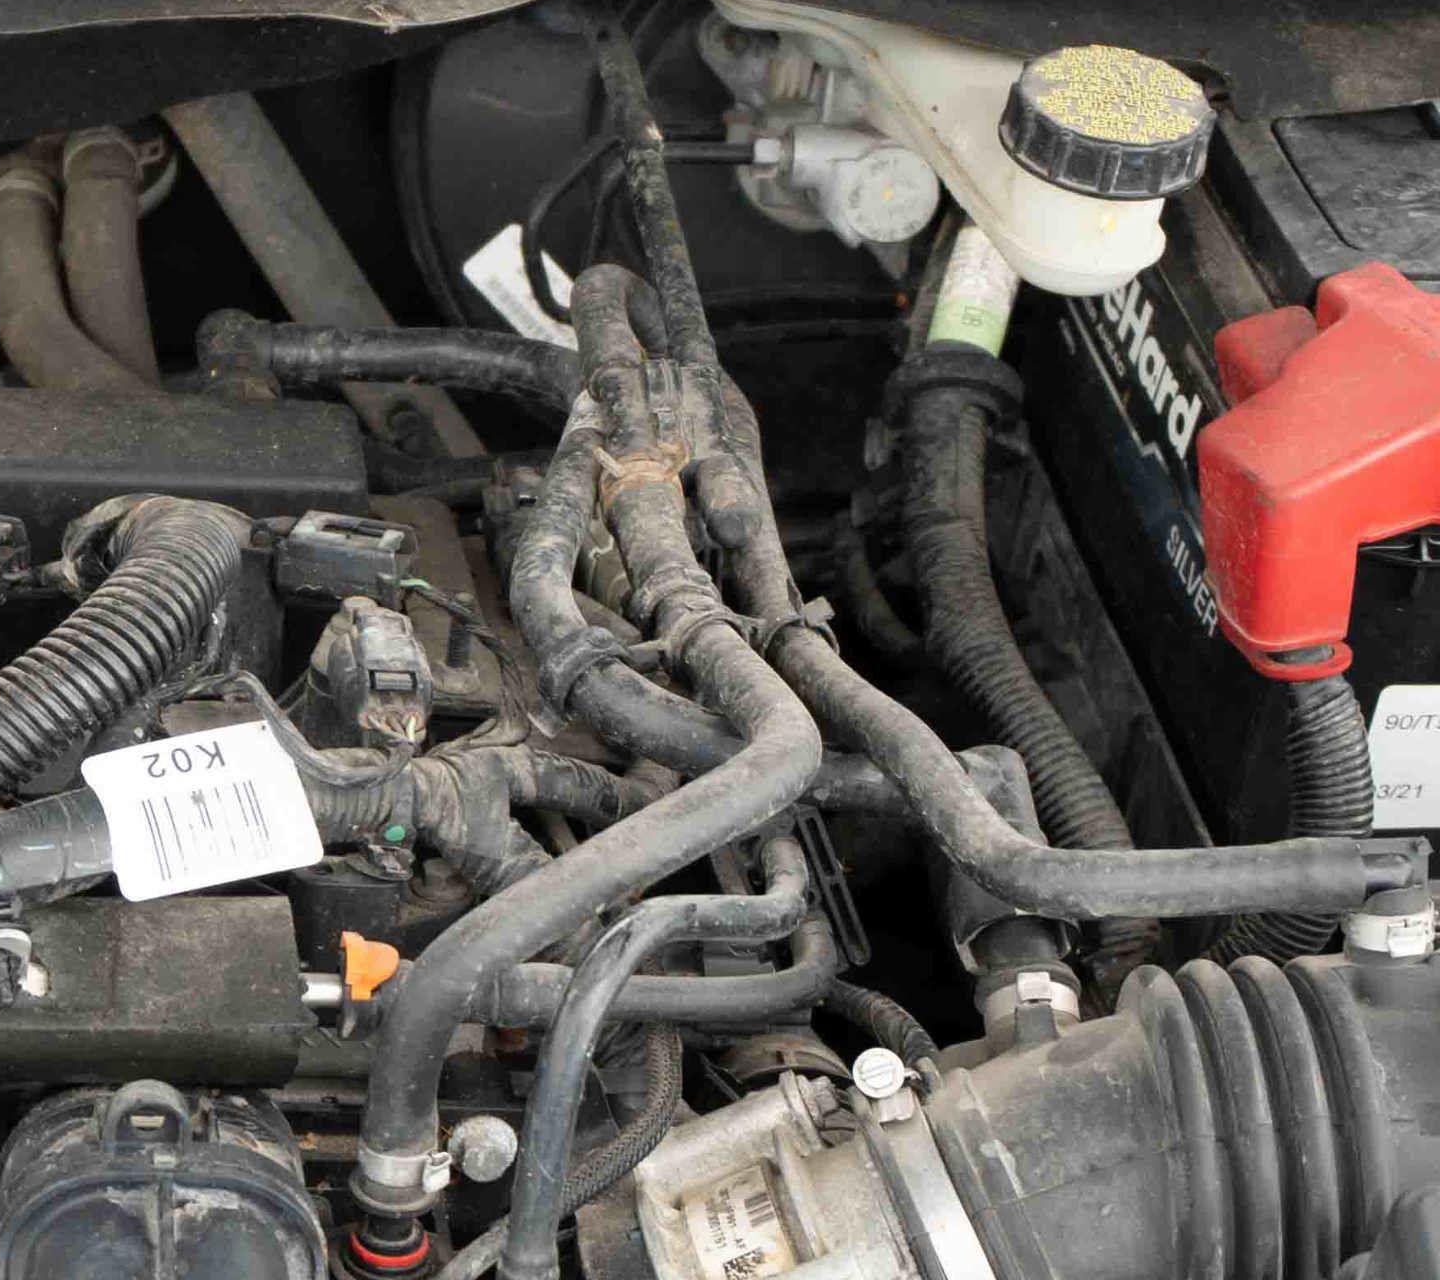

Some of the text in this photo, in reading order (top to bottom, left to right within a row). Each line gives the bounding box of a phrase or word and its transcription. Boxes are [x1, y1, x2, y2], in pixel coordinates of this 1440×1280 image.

[1104, 278, 1202, 459] eHard
[1165, 524, 1219, 638] SILVER
[143, 740, 226, 779] K02
[1373, 783, 1423, 799] 3/21
